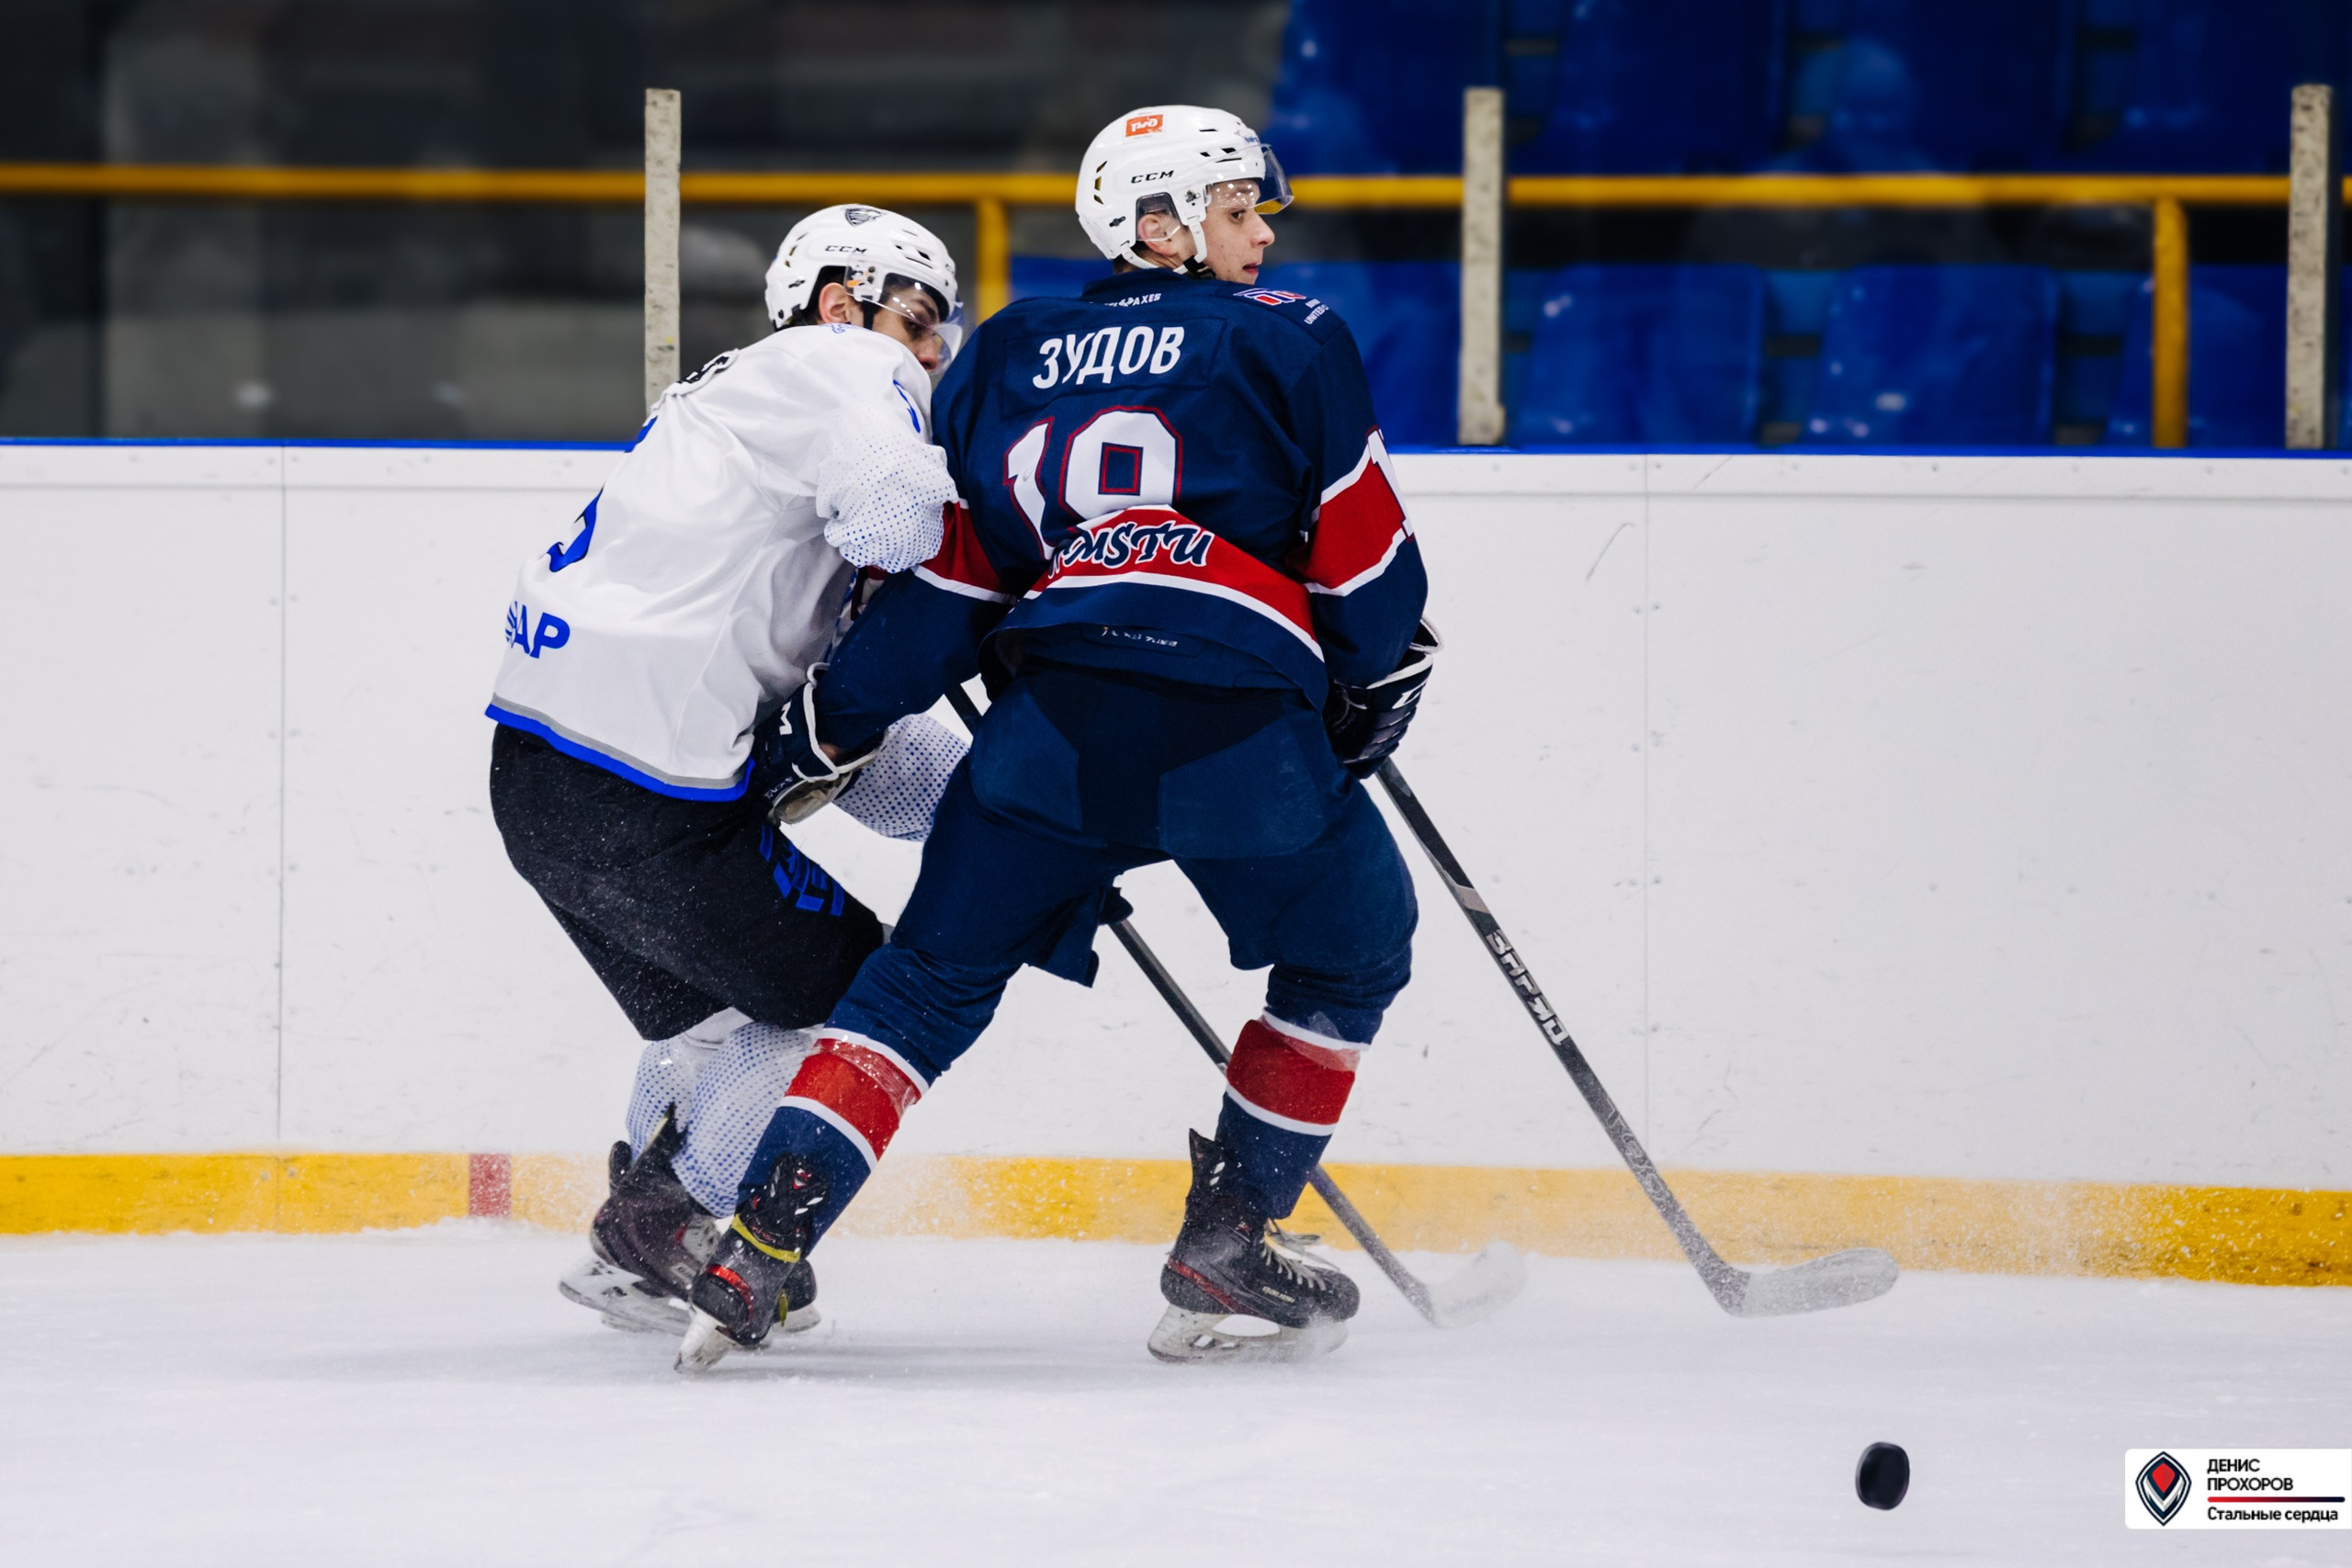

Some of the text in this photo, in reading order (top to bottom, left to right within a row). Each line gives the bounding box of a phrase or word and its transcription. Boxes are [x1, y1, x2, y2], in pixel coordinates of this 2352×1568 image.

[1130, 169, 1175, 185] CCM
[825, 244, 867, 254] CCM
[1033, 325, 1185, 389] ЗУДОВ
